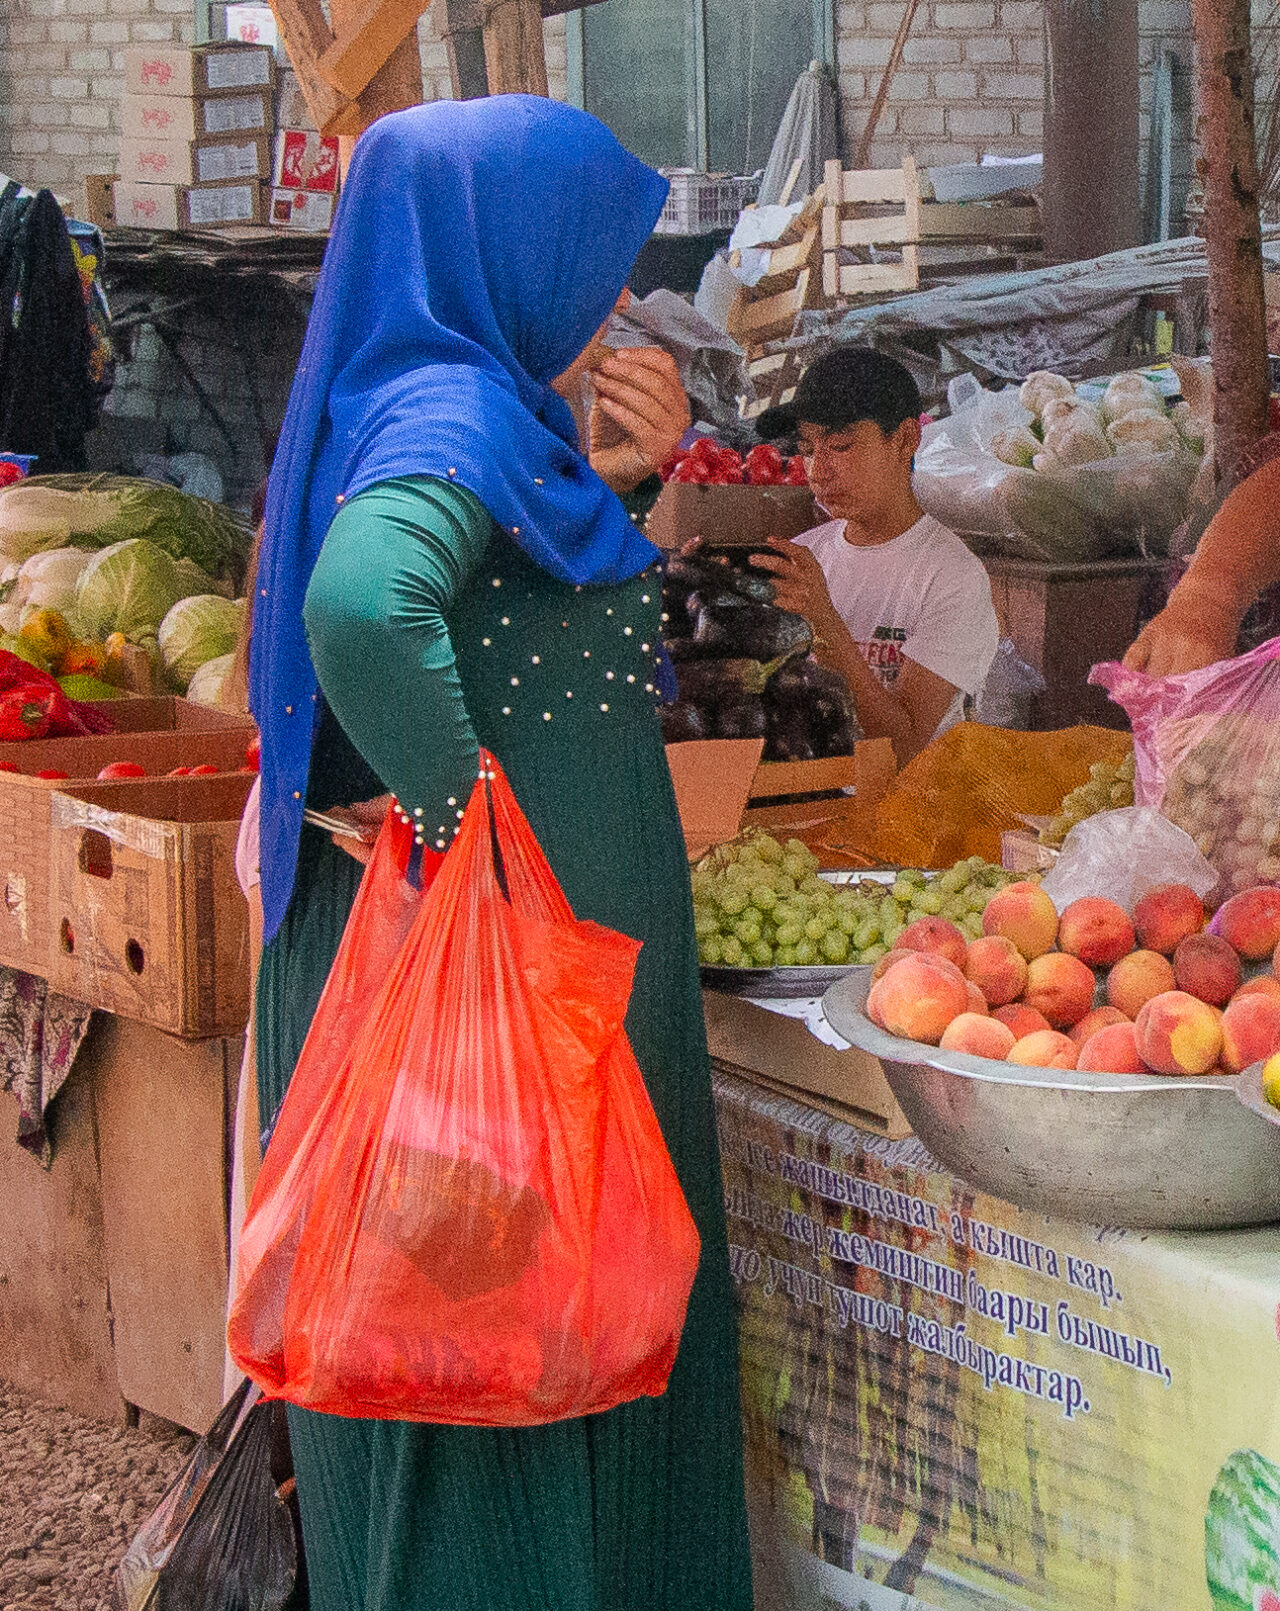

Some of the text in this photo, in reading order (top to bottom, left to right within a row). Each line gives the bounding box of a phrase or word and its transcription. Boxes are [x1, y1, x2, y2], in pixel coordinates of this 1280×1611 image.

[781, 1208, 824, 1260] жер
[826, 1225, 965, 1307] жемиштин
[966, 1268, 1049, 1338] баары
[1057, 1300, 1173, 1392] бышып,
[951, 1212, 965, 1245] а
[968, 1218, 1060, 1279] кышта
[1064, 1253, 1123, 1310] кар.
[906, 1311, 1091, 1420] жалбырактар.
